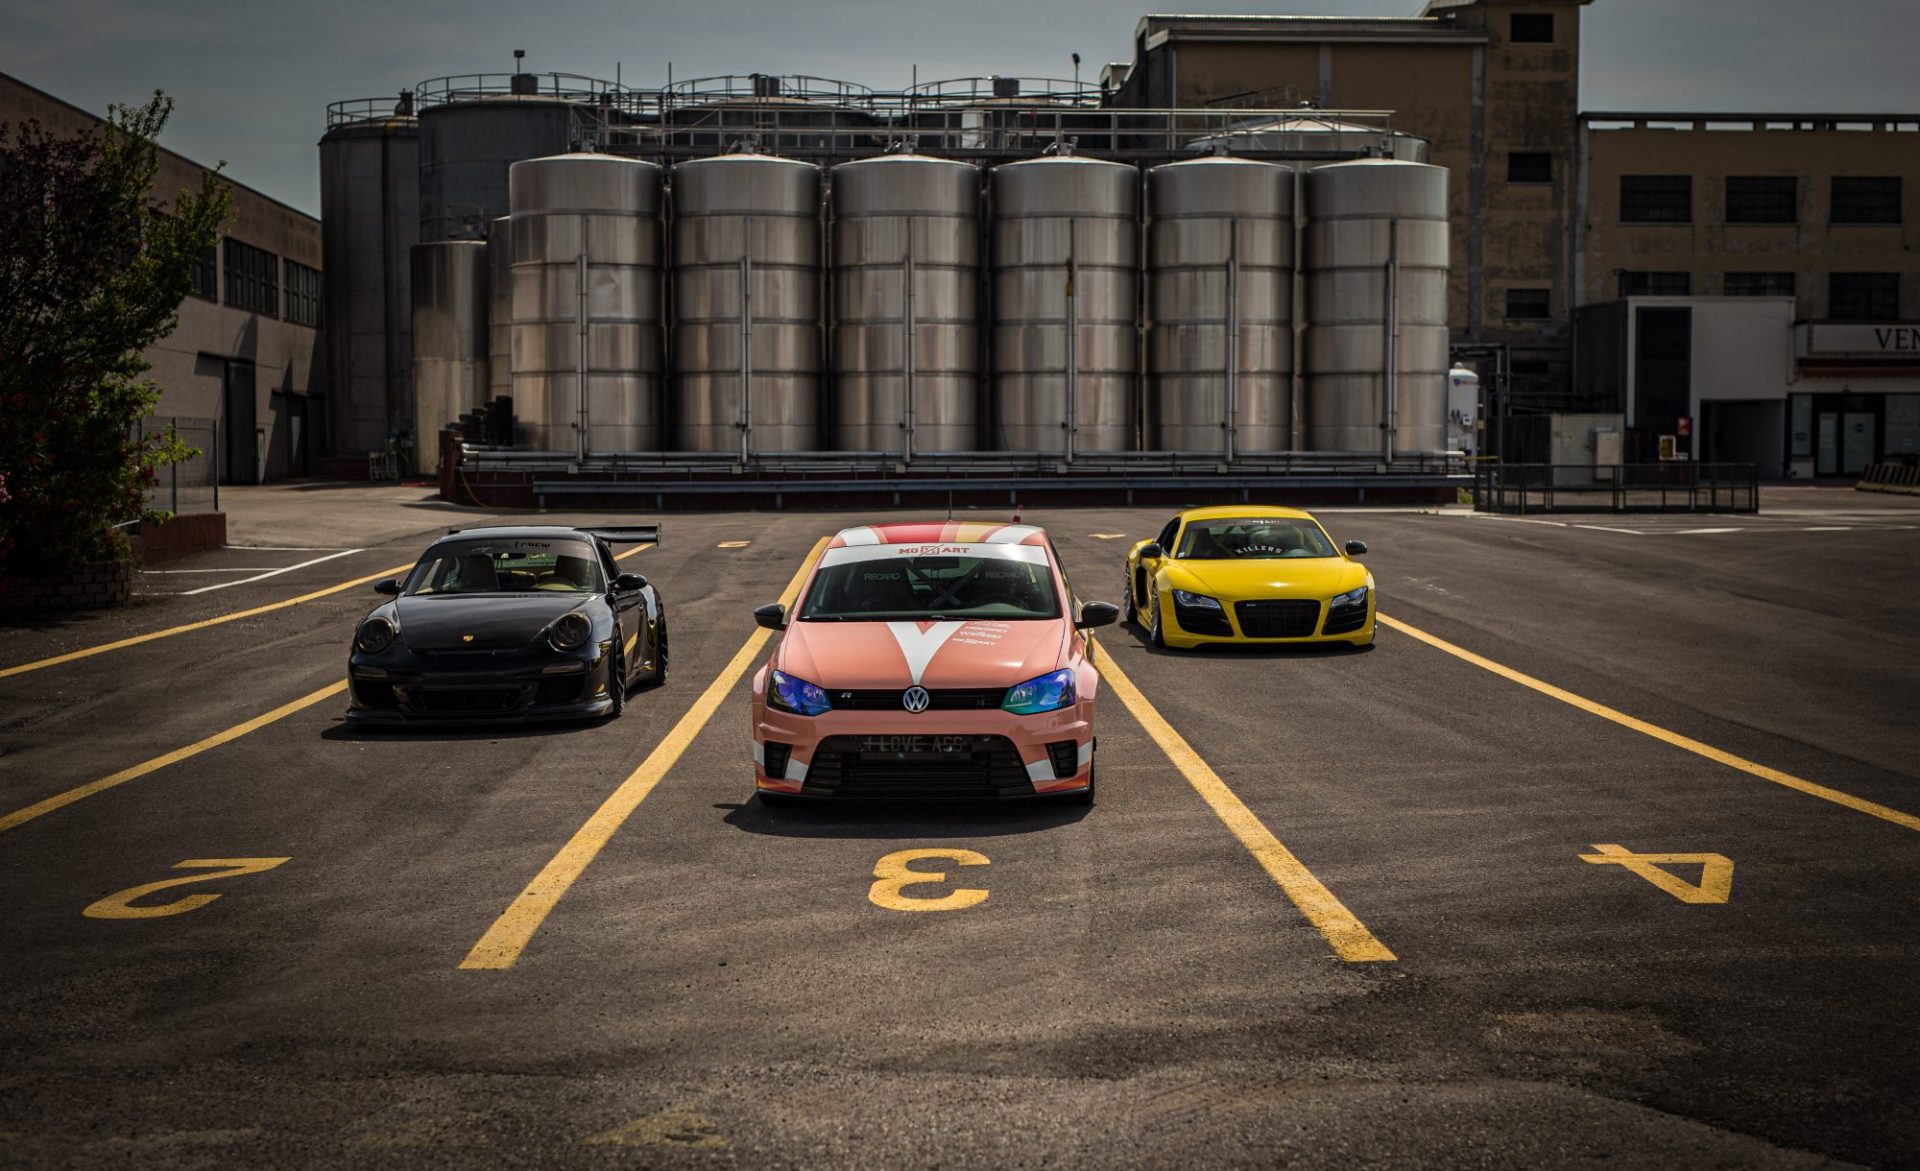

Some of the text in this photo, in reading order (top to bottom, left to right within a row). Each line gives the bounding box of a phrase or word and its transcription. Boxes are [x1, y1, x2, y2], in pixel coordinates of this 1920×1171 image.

[1235, 545, 1283, 554] KILLERS
[82, 857, 292, 919] 2
[868, 848, 991, 911] 3
[1577, 844, 1734, 904] 4
